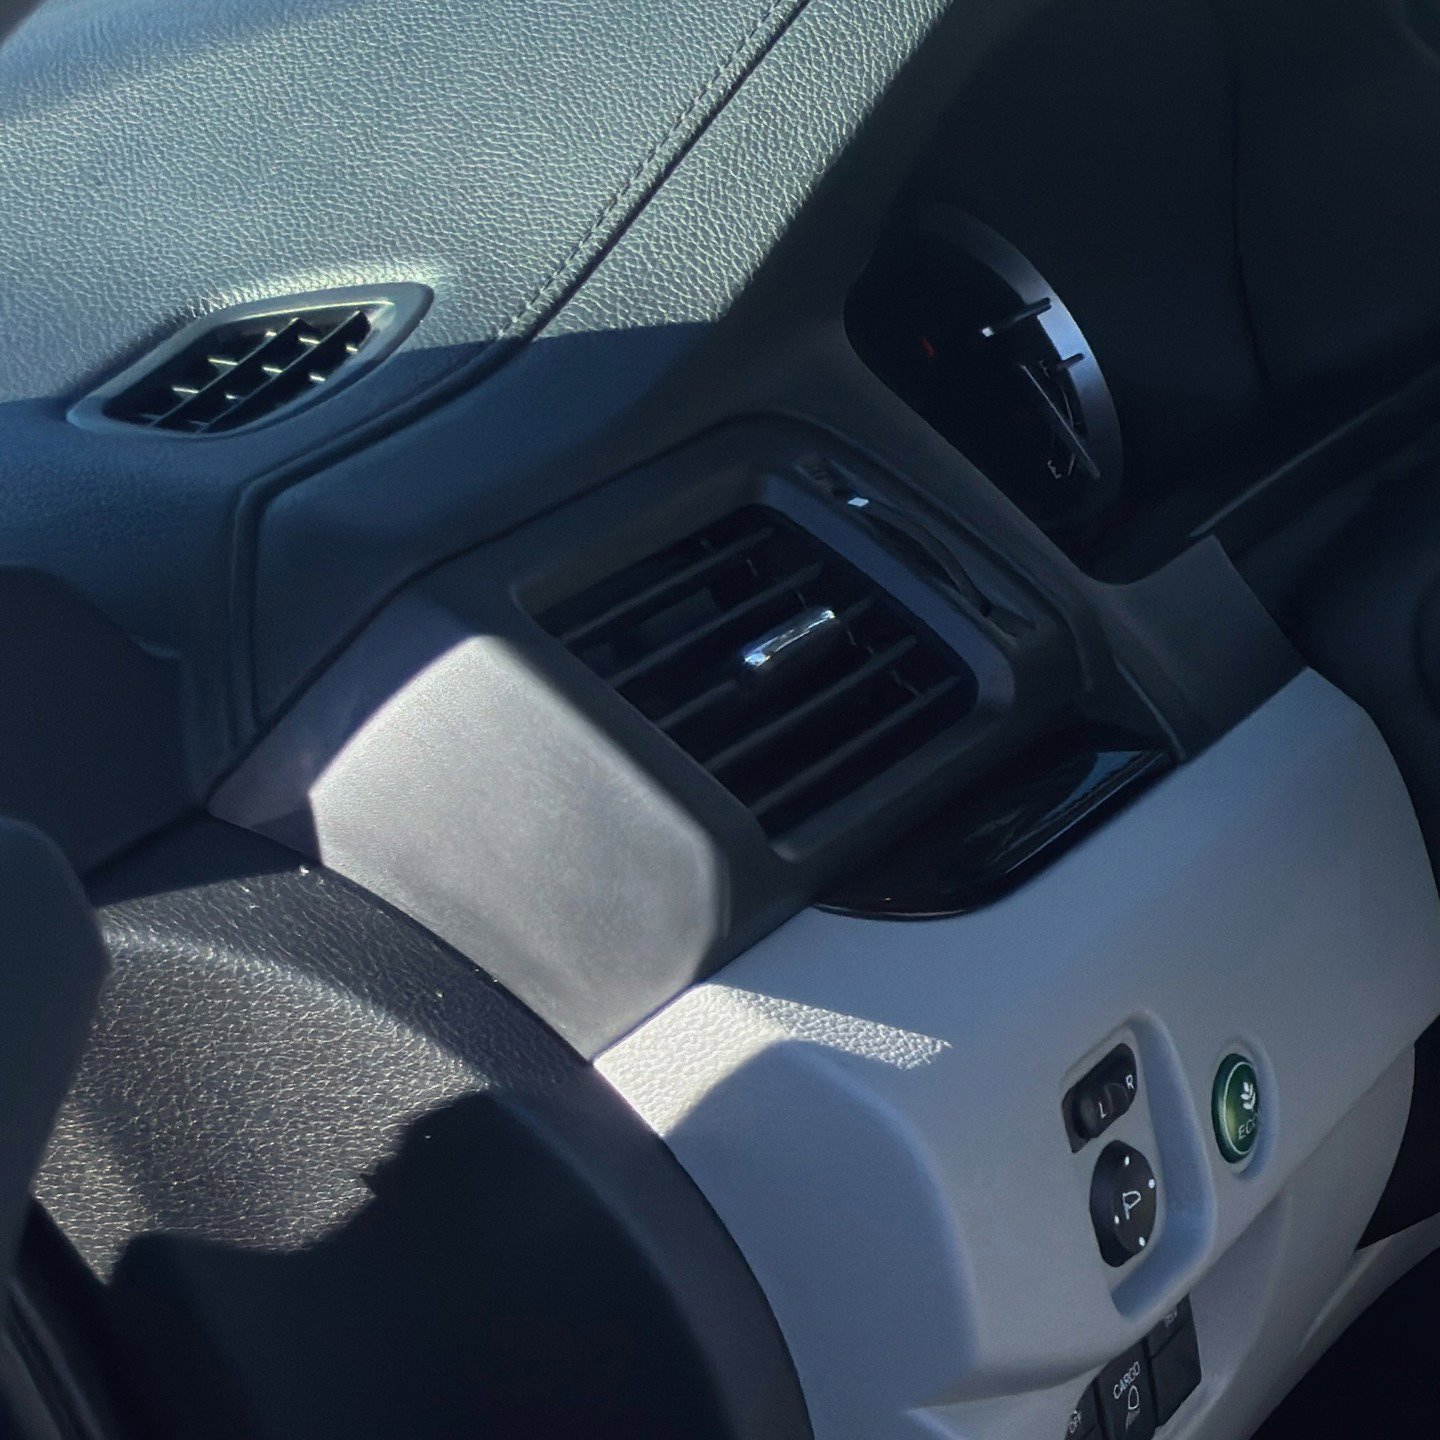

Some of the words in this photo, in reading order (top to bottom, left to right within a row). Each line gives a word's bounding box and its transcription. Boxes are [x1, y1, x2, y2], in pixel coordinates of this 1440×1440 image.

[1125, 1074, 1135, 1090] R
[1098, 1103, 1108, 1119] L
[1113, 1361, 1141, 1400] CARGO
